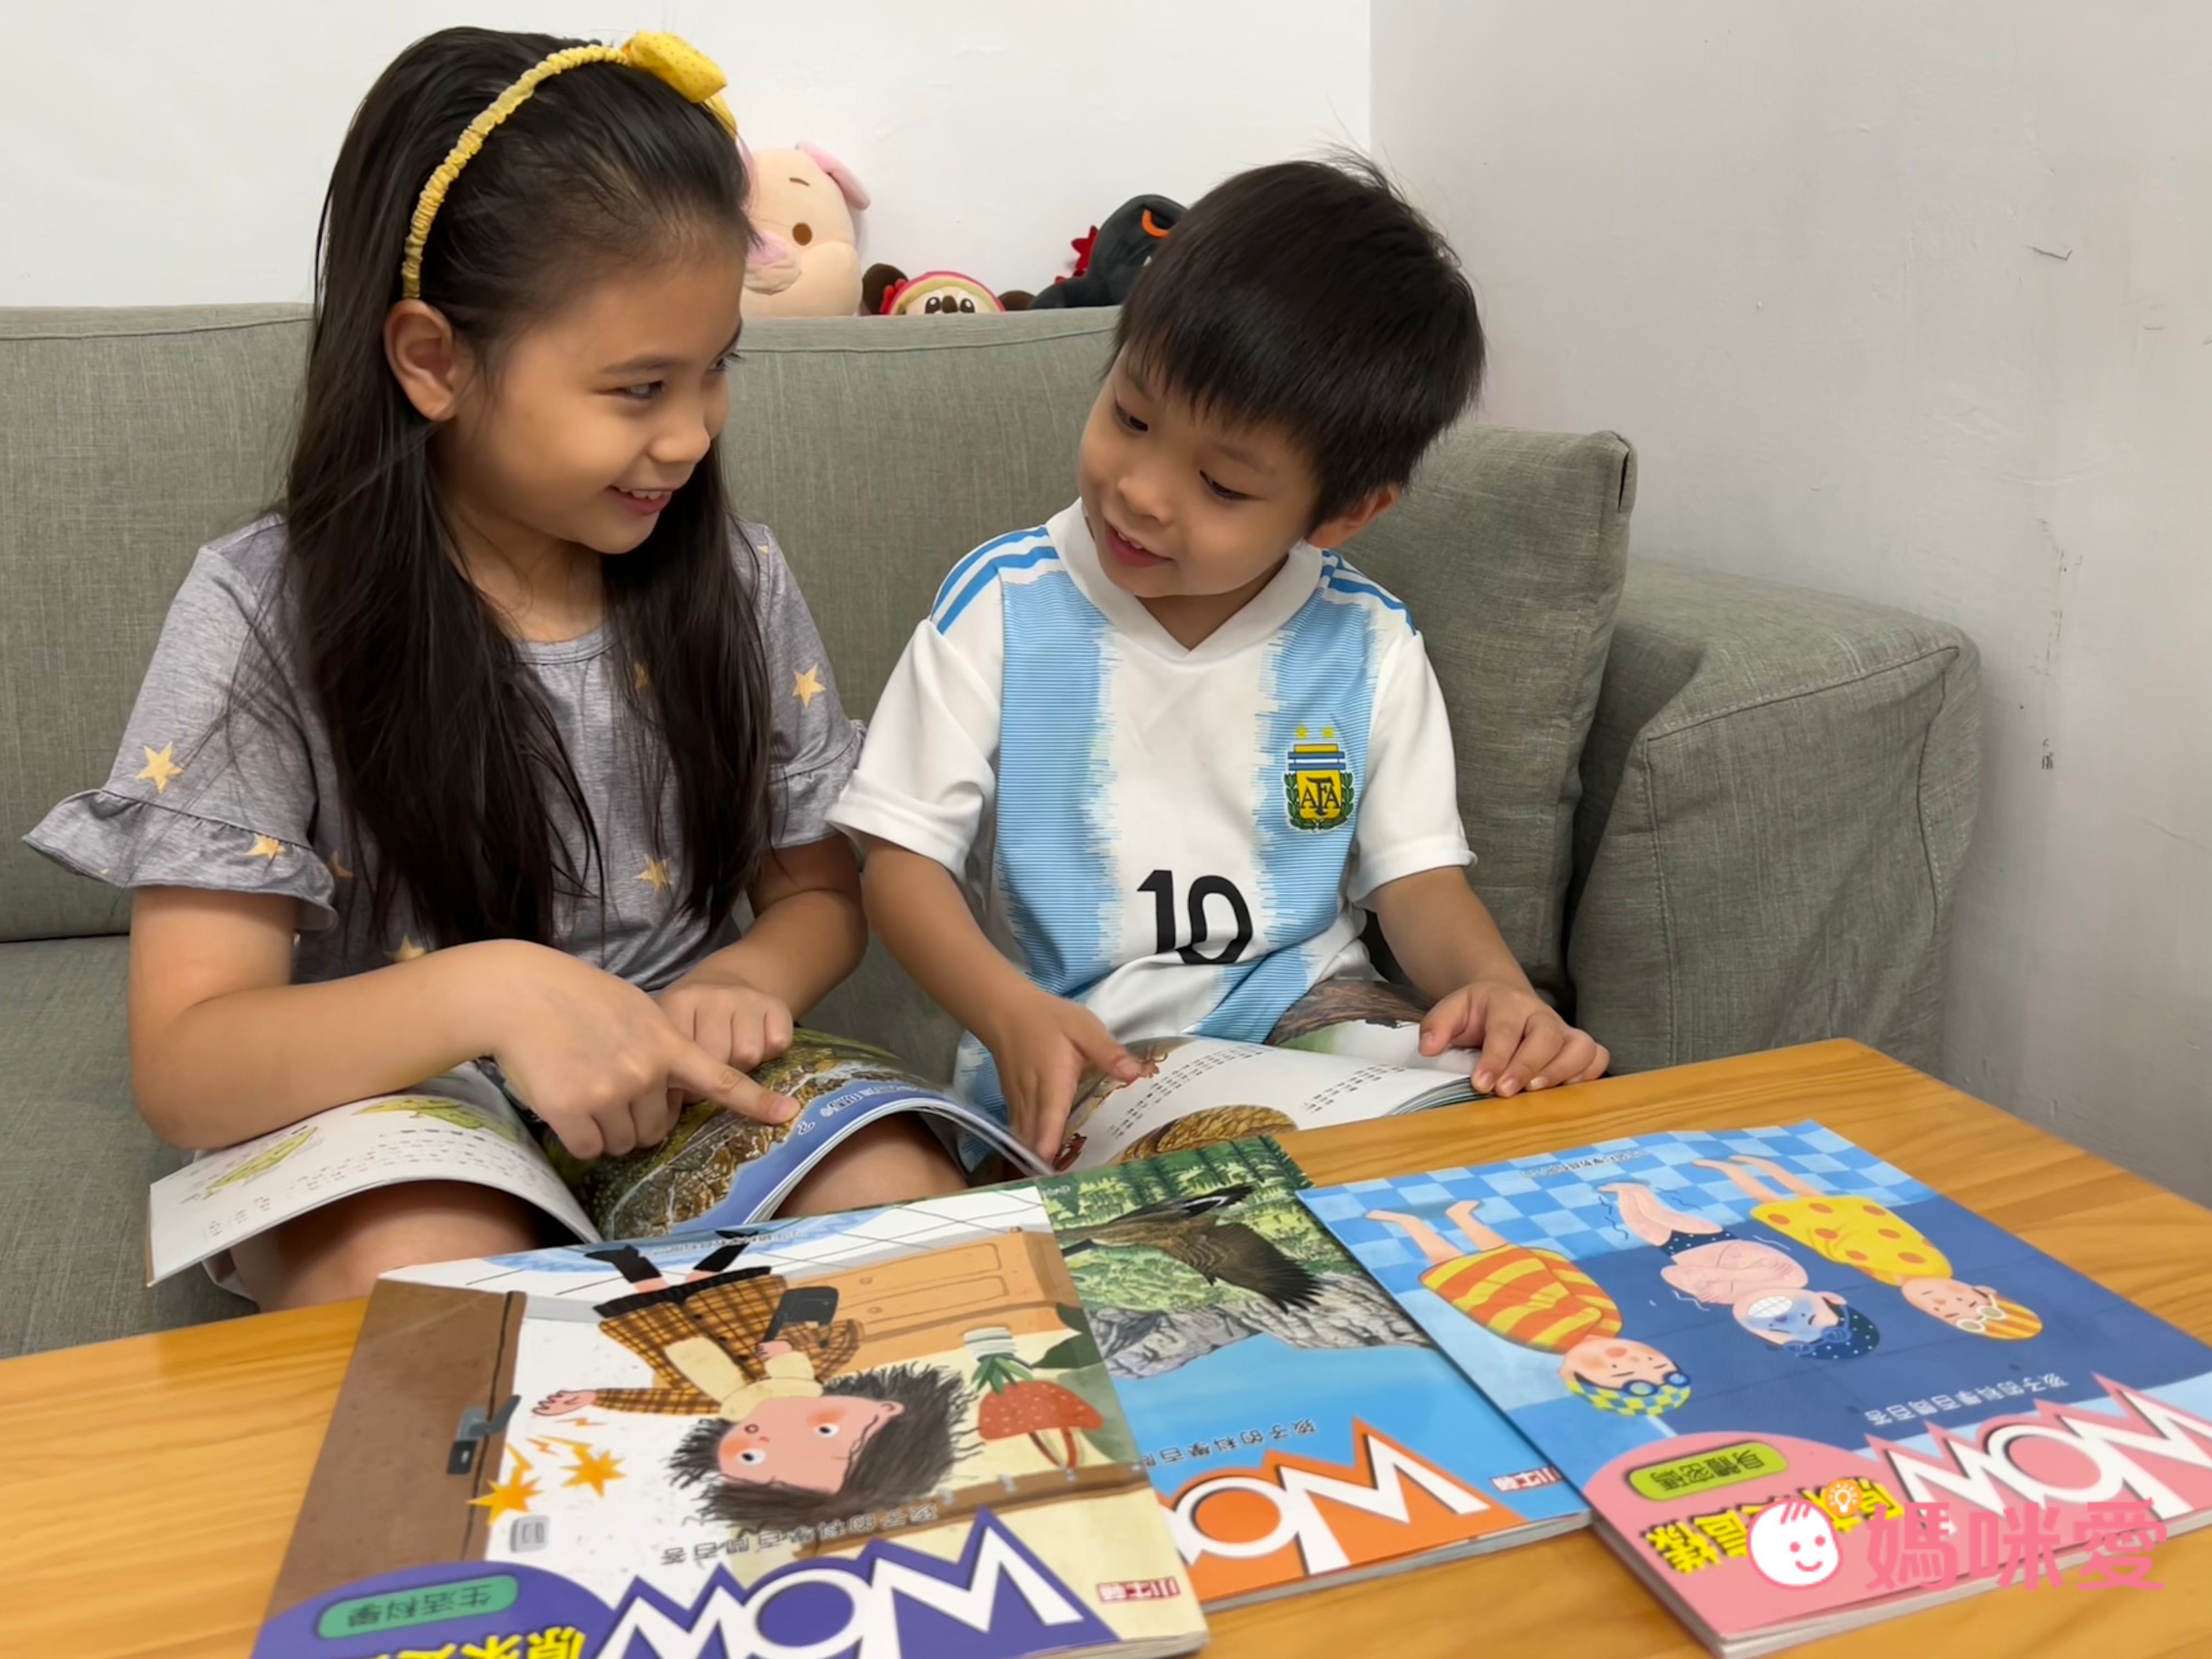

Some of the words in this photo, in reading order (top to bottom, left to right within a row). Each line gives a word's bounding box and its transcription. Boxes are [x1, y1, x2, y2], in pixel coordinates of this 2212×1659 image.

[1136, 870, 1254, 964] 10
[348, 1584, 492, 1627] 生活科學
